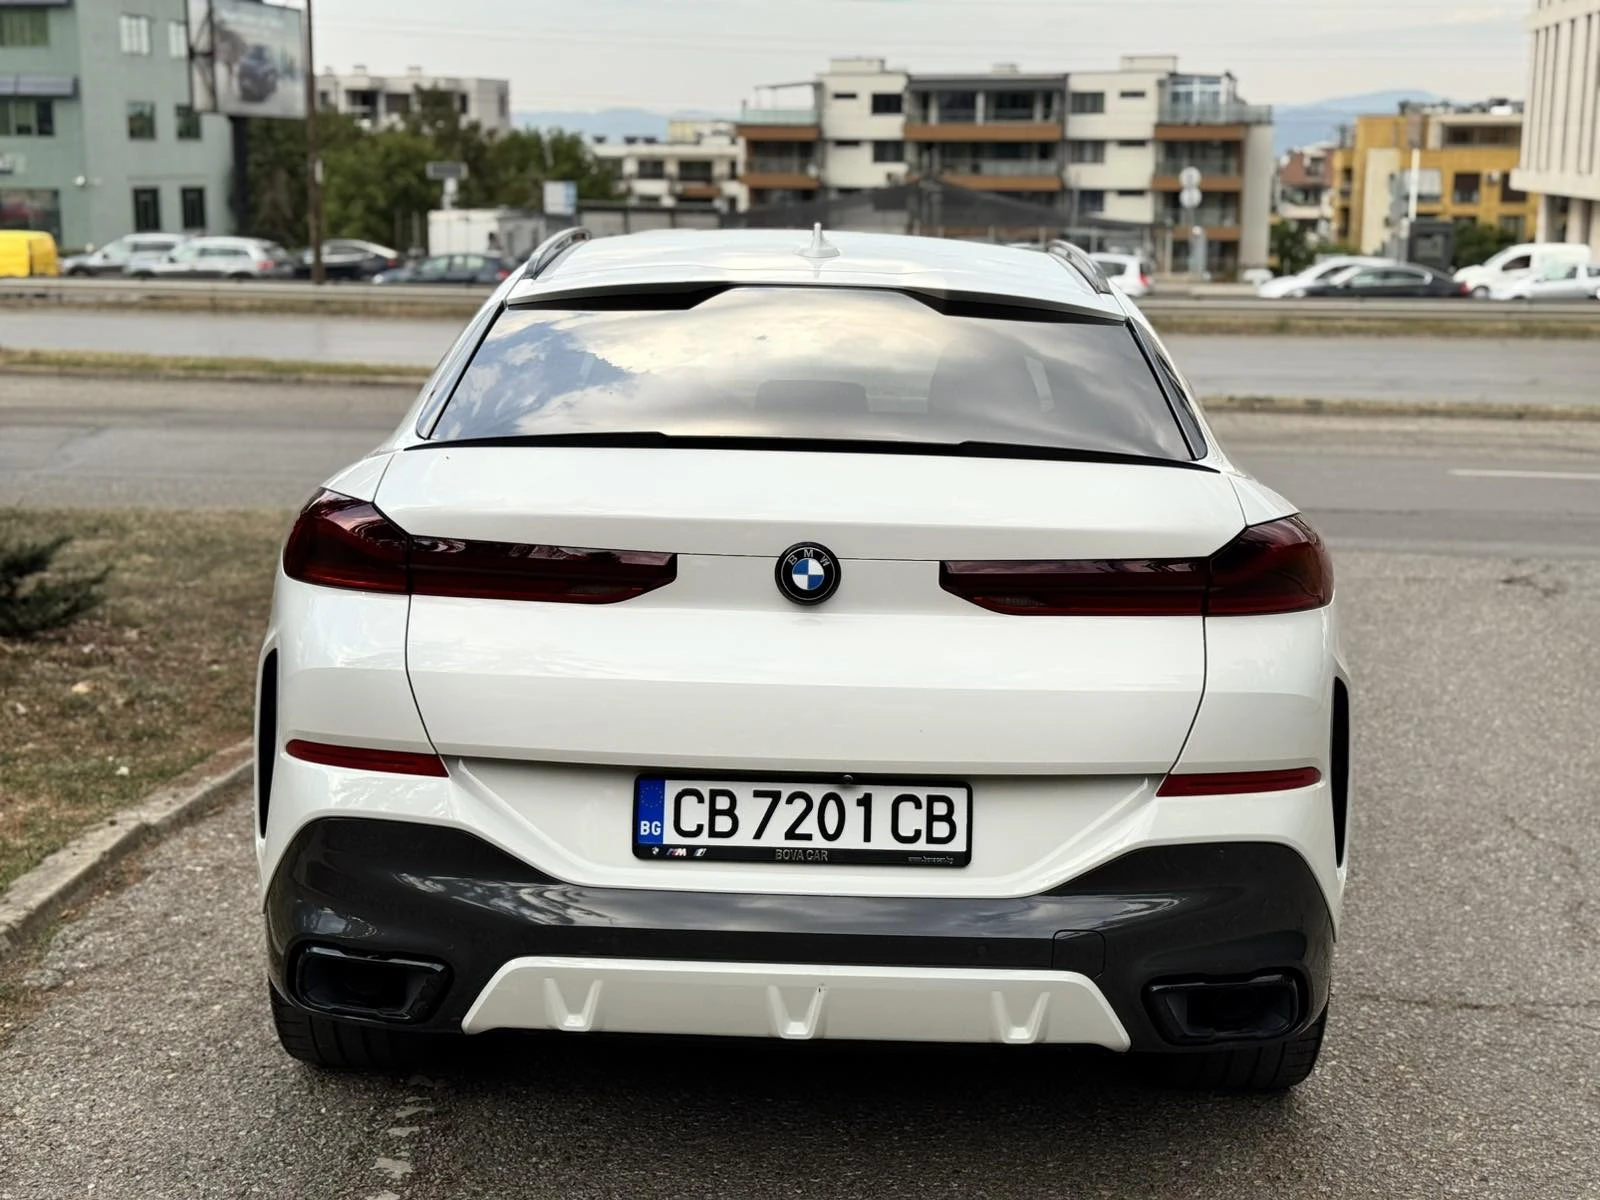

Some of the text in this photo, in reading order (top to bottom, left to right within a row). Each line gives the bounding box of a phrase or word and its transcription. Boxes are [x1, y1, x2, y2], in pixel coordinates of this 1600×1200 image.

[787, 549, 830, 567] BMW
[673, 788, 957, 845] CB 7201 CB
[640, 820, 661, 836] BG
[775, 849, 828, 862] BOVA CAR
